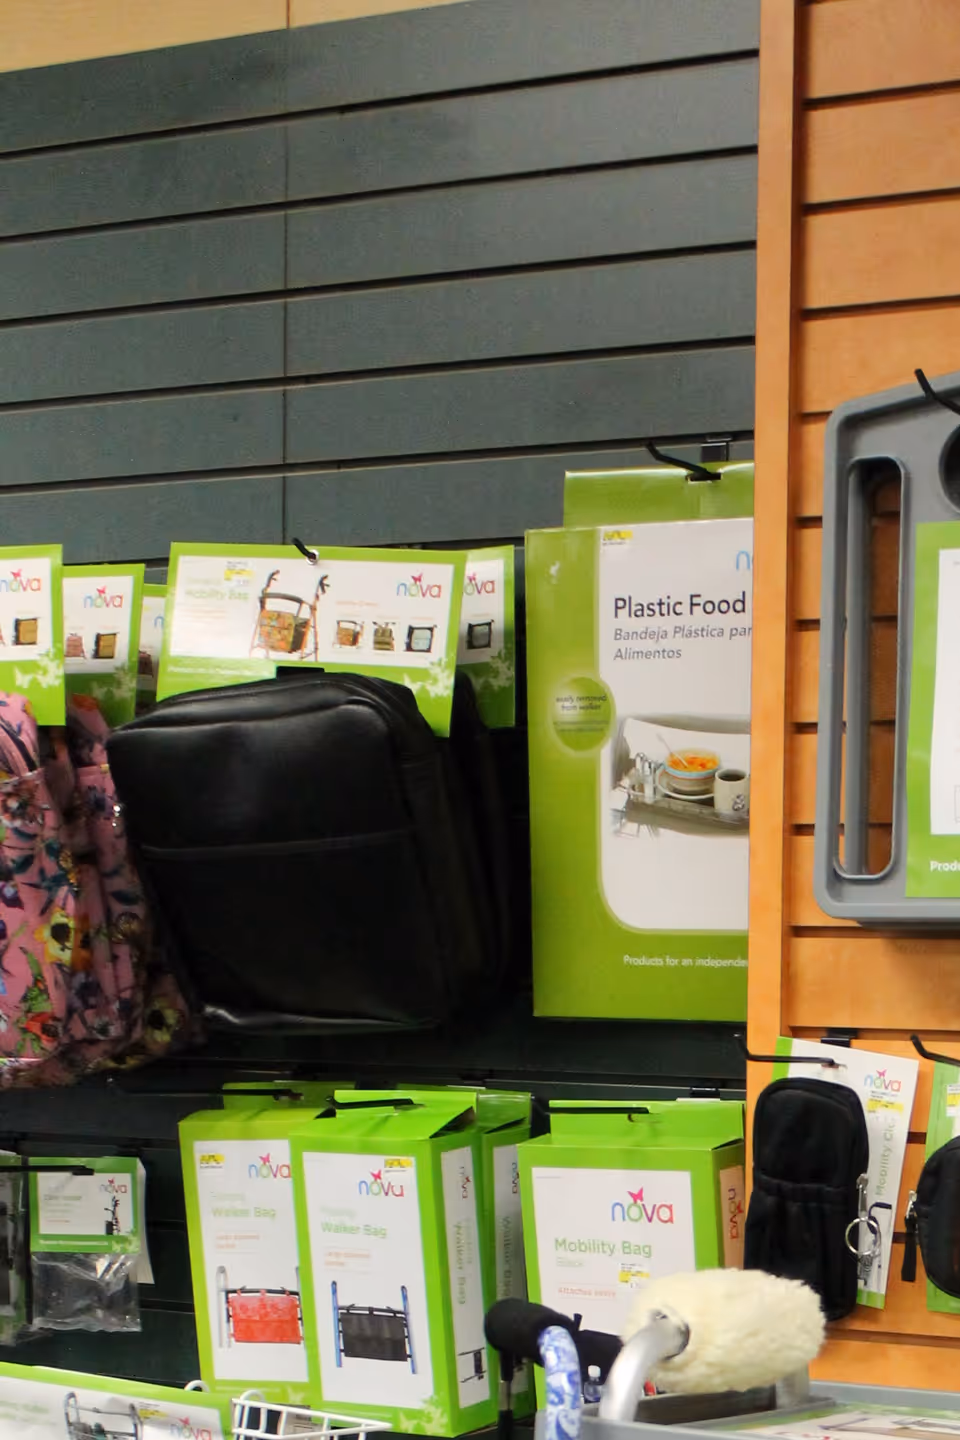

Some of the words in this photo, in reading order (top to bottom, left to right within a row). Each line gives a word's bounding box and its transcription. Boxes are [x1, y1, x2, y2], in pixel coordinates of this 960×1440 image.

[0, 577, 41, 593] nova
[397, 583, 441, 598] nova
[464, 580, 495, 596] ova
[84, 594, 123, 609] nova
[614, 596, 683, 618] Plastic
[689, 591, 746, 615] Food
[614, 628, 668, 643] Bandeja
[672, 625, 724, 639] Plástica
[613, 648, 682, 661] Alimentos
[624, 955, 663, 966] Products
[666, 956, 678, 966] for
[681, 957, 692, 966] an
[864, 1075, 901, 1092] nova
[249, 1163, 291, 1179] nova
[875, 1146, 892, 1196] Mobility
[100, 1184, 127, 1193] nova
[611, 1202, 674, 1225] nova
[728, 1188, 739, 1240] nova
[321, 1222, 360, 1235] Walker
[364, 1224, 387, 1238] Bag
[554, 1237, 616, 1256] Mobility
[621, 1241, 652, 1259] Bag
